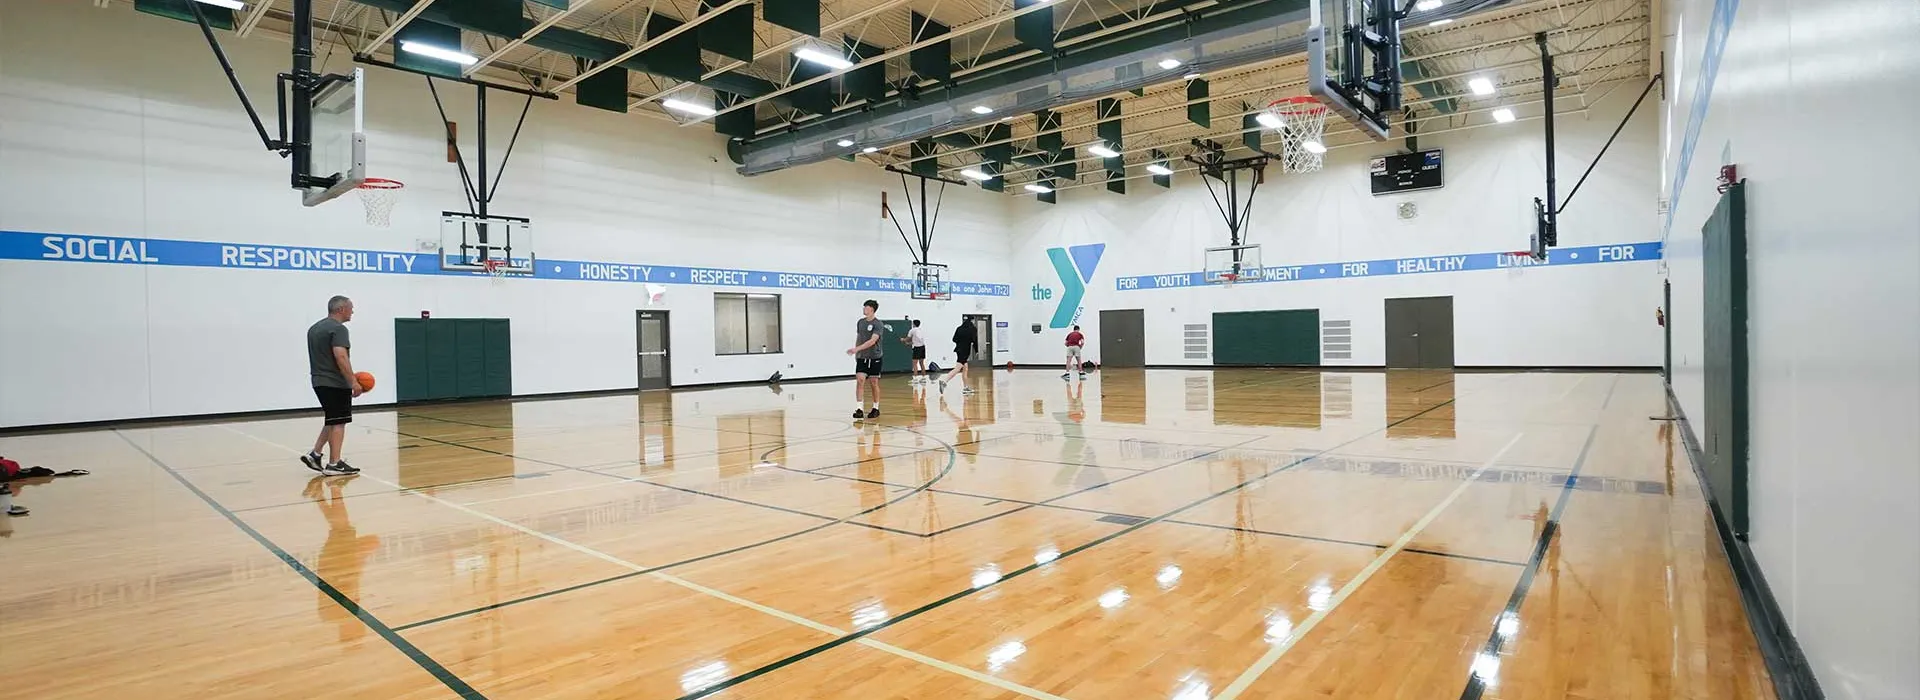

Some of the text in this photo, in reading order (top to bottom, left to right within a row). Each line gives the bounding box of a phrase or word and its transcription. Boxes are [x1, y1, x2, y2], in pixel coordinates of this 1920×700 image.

[42, 236, 417, 272] SOCIAL RESPONSIBILITY
[1342, 263, 1368, 276] FOR
[1396, 256, 1467, 274] HEALTHY
[1598, 245, 1635, 261] FOR
[579, 263, 859, 289] HONESTY RESPECT RESPONSIBILITY
[1119, 278, 1138, 289] FOR
[1153, 275, 1190, 287] YOUTH
[1032, 283, 1052, 300] the
[1071, 305, 1084, 326] YMCA
